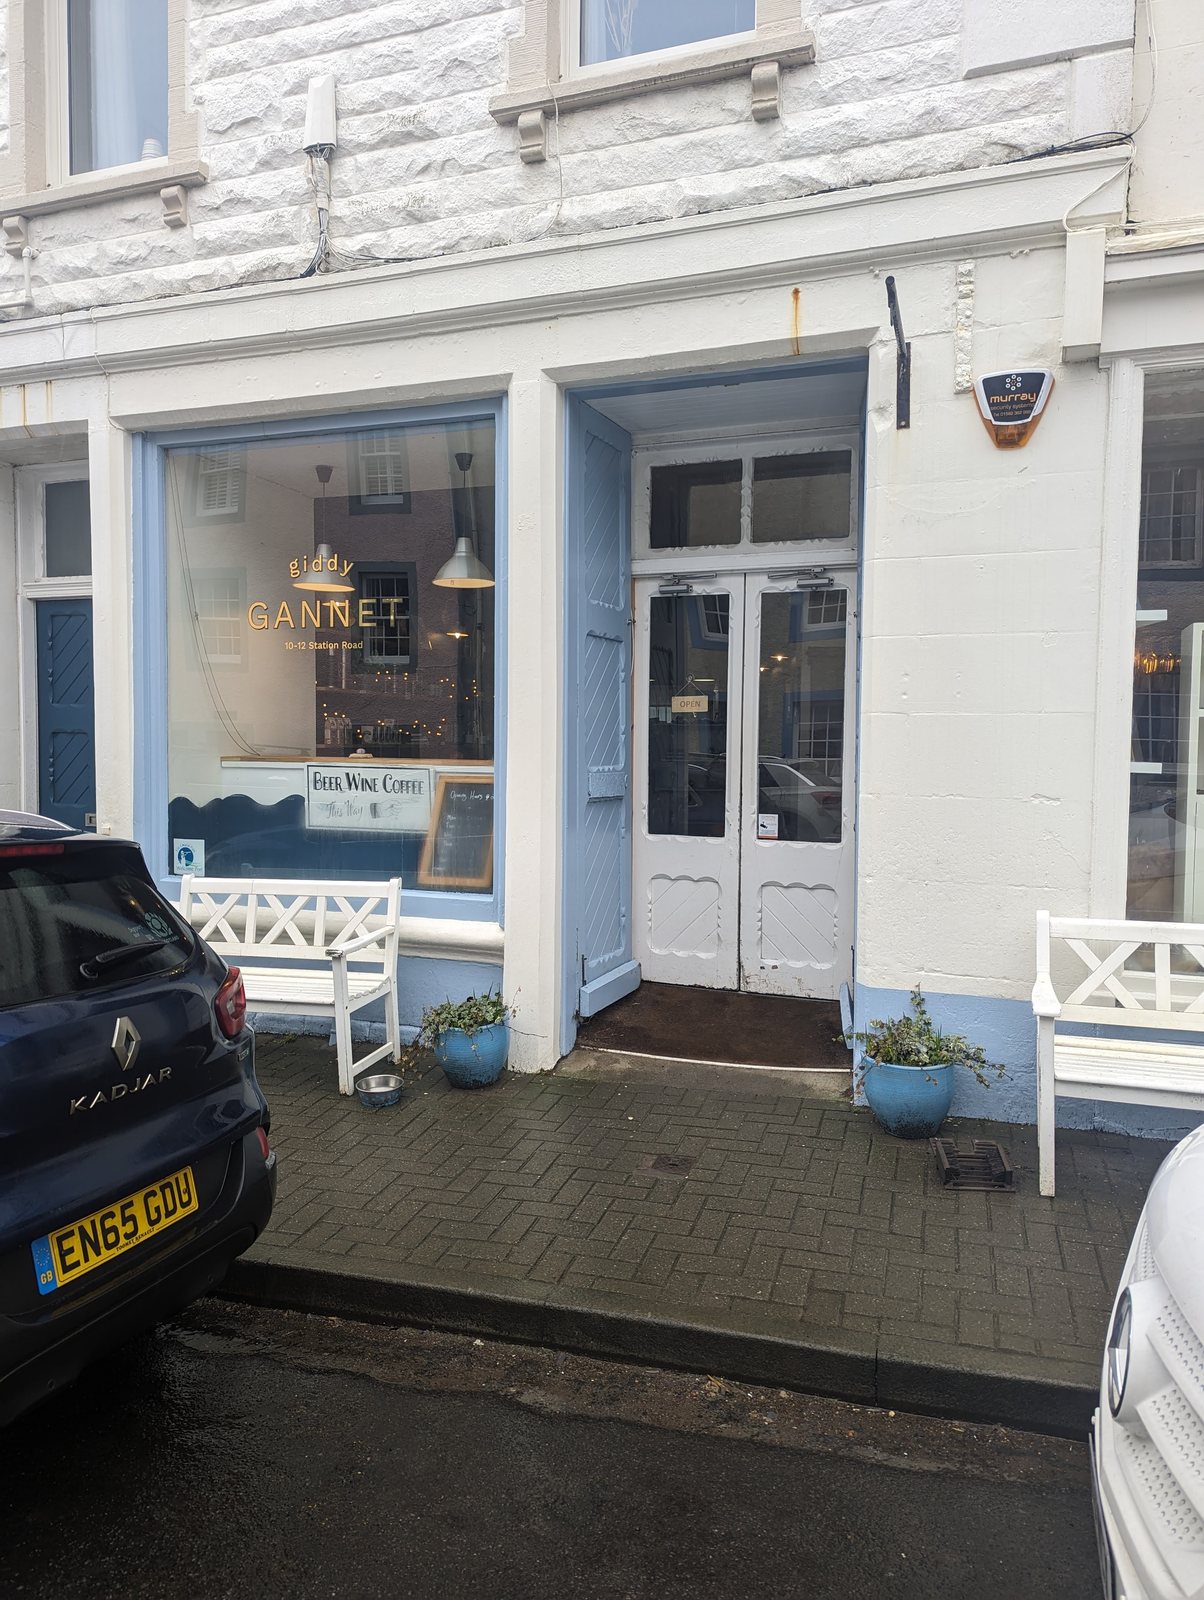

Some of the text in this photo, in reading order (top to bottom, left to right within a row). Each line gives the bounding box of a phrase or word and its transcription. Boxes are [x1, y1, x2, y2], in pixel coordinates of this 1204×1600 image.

[990, 393, 1036, 403] murray
[289, 553, 354, 578] giddy
[248, 598, 403, 630] GANNET
[284, 641, 364, 650] 10-12 Station Road
[680, 700, 701, 708] OPEN
[69, 1066, 173, 1116] KADJAR
[56, 1172, 192, 1276] EN65 GDU
[40, 1270, 54, 1285] GB
